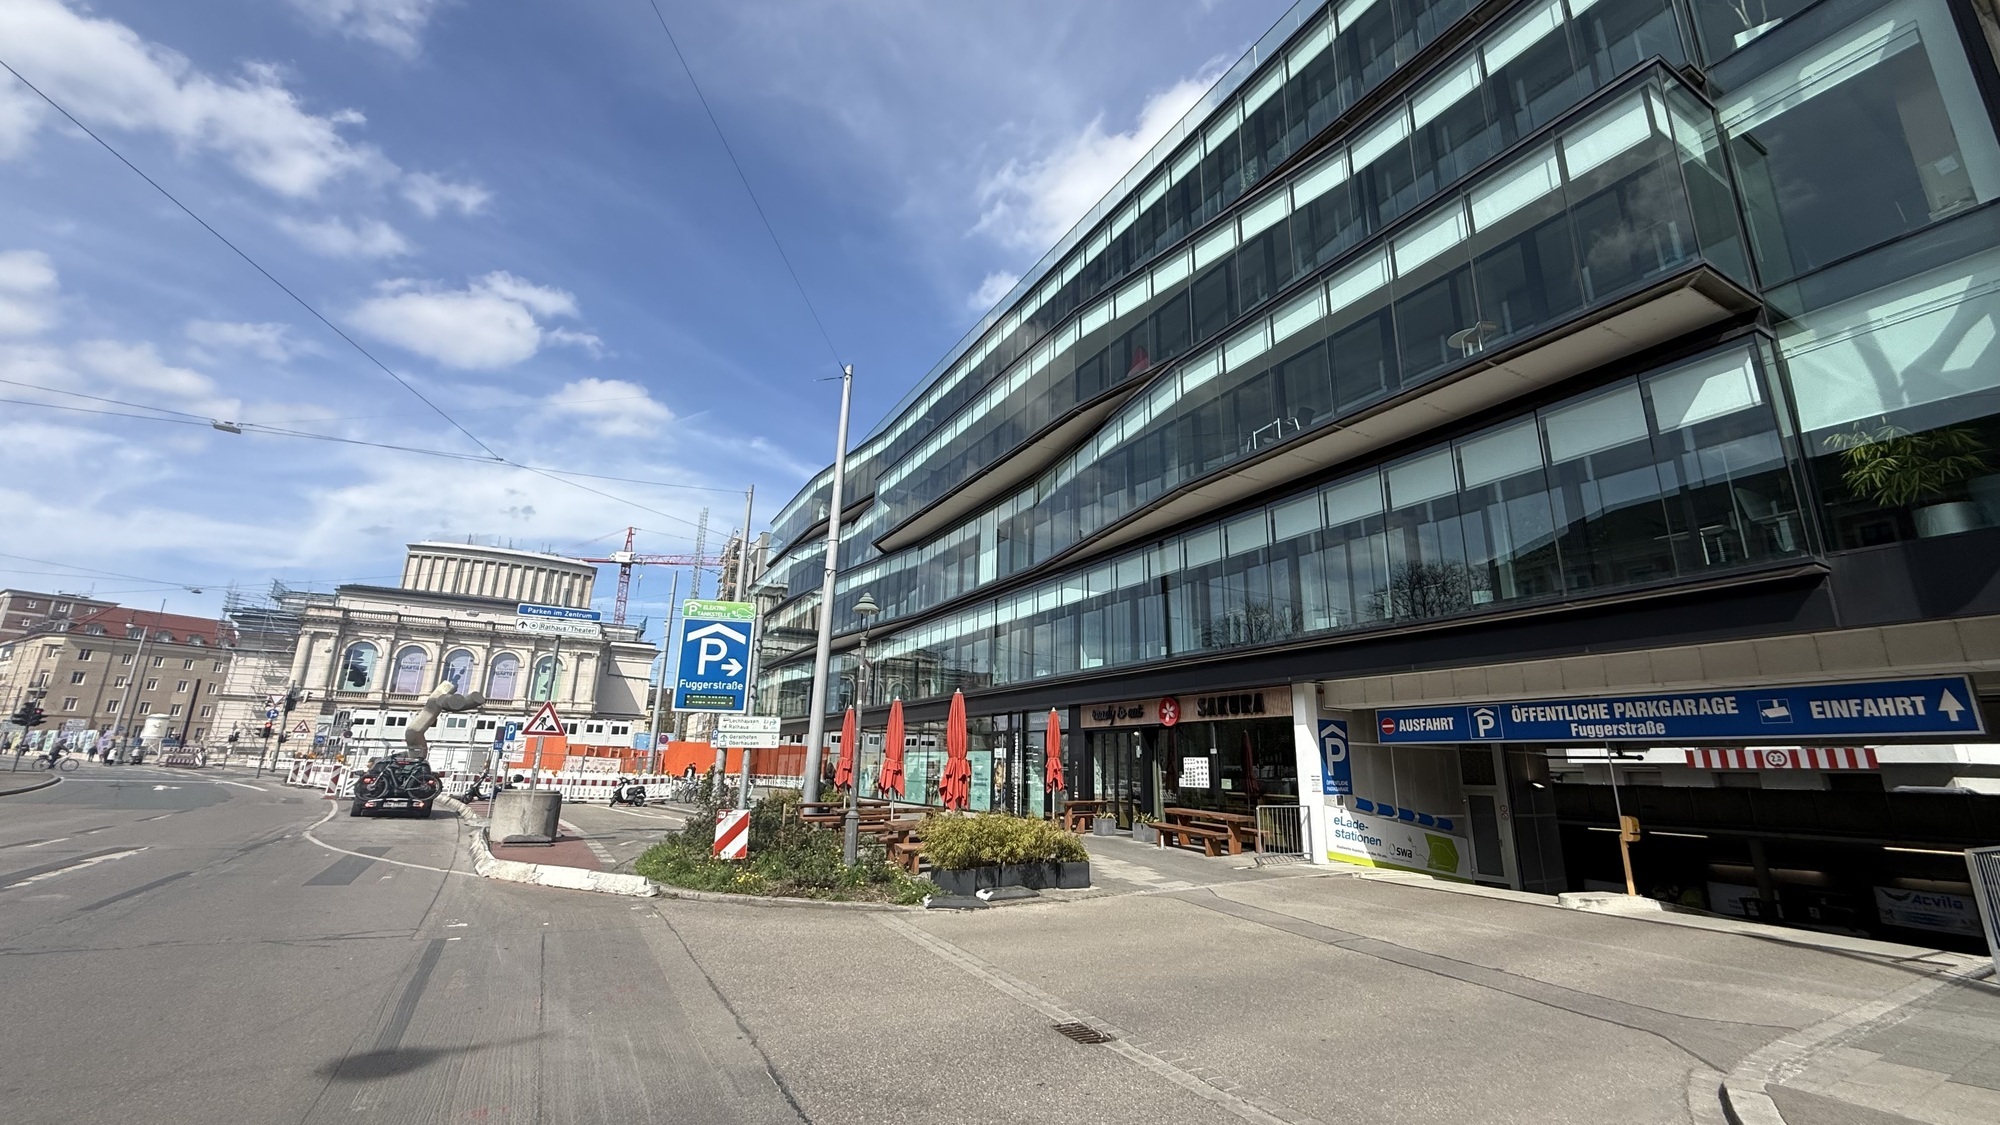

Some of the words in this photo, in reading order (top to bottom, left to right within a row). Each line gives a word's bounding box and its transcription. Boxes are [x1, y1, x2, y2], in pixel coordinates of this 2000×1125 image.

[527, 607, 552, 616] Parken
[564, 611, 593, 619] Zentrum
[540, 623, 595, 634] Rathaus/Theater
[697, 638, 728, 675] P
[679, 679, 744, 691] Fuggerstraße
[1198, 692, 1266, 717] SAKURA
[1511, 701, 1609, 723] ÖFFENTLICHE
[1613, 695, 1739, 719] PARKGARAGE
[1809, 695, 1926, 720] EINFAHRT
[1091, 704, 1116, 725] ready
[1128, 704, 1144, 718] eat
[507, 725, 515, 739] P
[1399, 716, 1454, 733] AUSFAHRT
[1570, 721, 1666, 739] Fuggerstraße
[1325, 737, 1346, 777] P
[1333, 815, 1369, 831] eLade-
[1335, 828, 1382, 847] stationen
[1396, 846, 1413, 859] swa
[1910, 894, 1964, 910] Acvila
